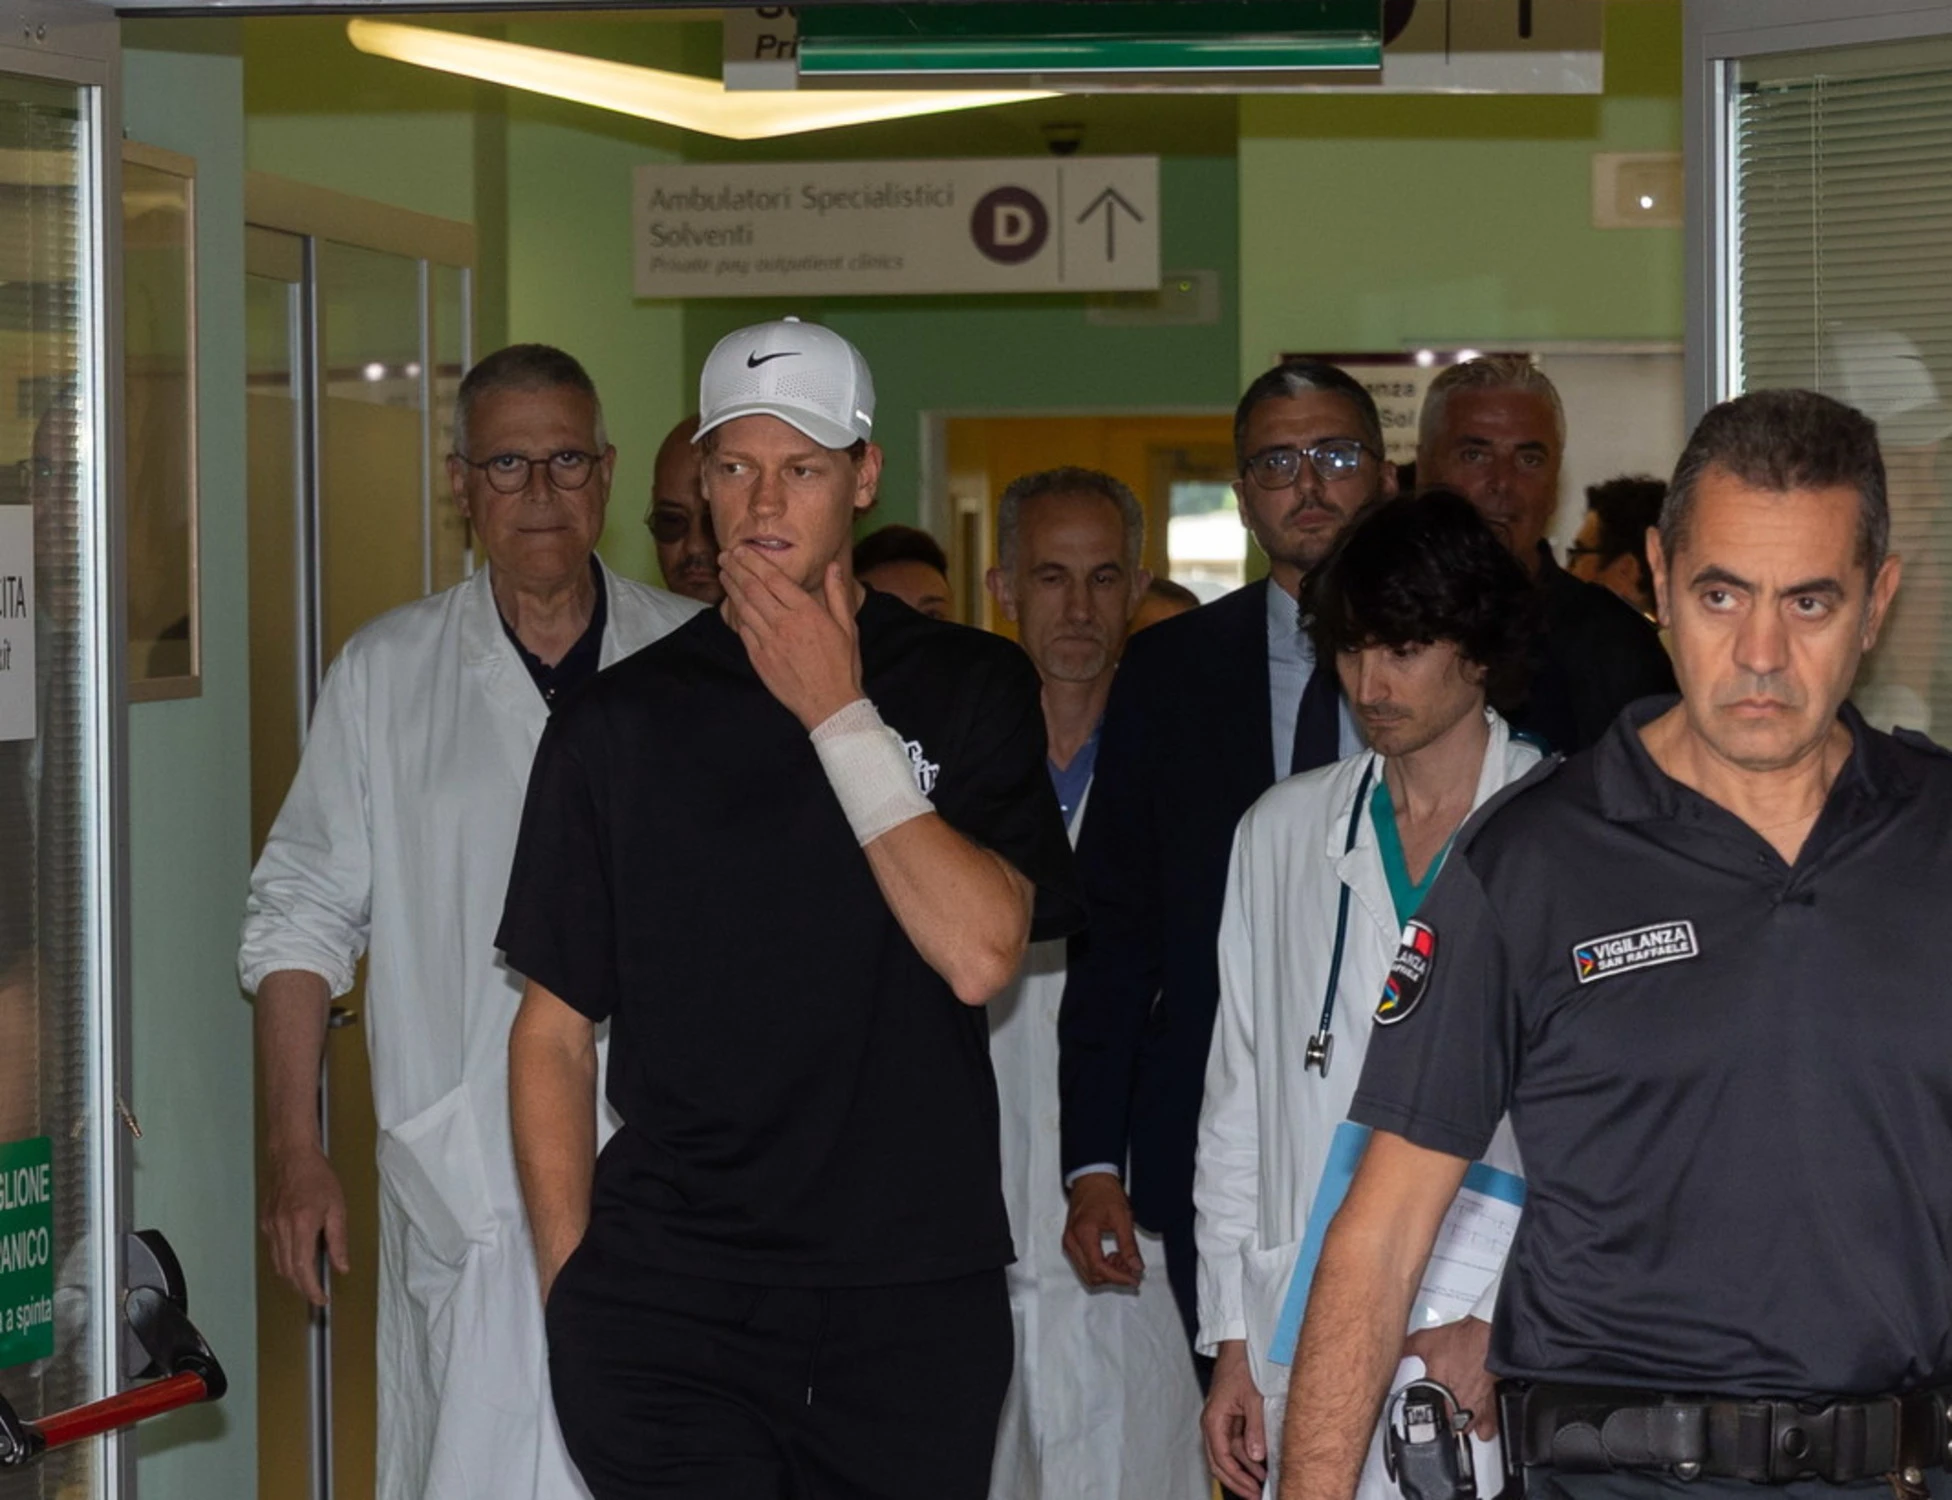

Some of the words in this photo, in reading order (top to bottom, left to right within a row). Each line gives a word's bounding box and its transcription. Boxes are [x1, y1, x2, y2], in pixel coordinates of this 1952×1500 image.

[649, 184, 791, 211] Ambulatori
[801, 181, 955, 216] Specialistici
[649, 221, 754, 248] Solventi
[993, 205, 1034, 246] D
[0, 576, 27, 619] ITA
[1592, 926, 1688, 960] VIGILANZA
[1597, 954, 1624, 970] SAN
[1626, 941, 1690, 963] RAFFAELE
[15, 1295, 52, 1336] spinta
